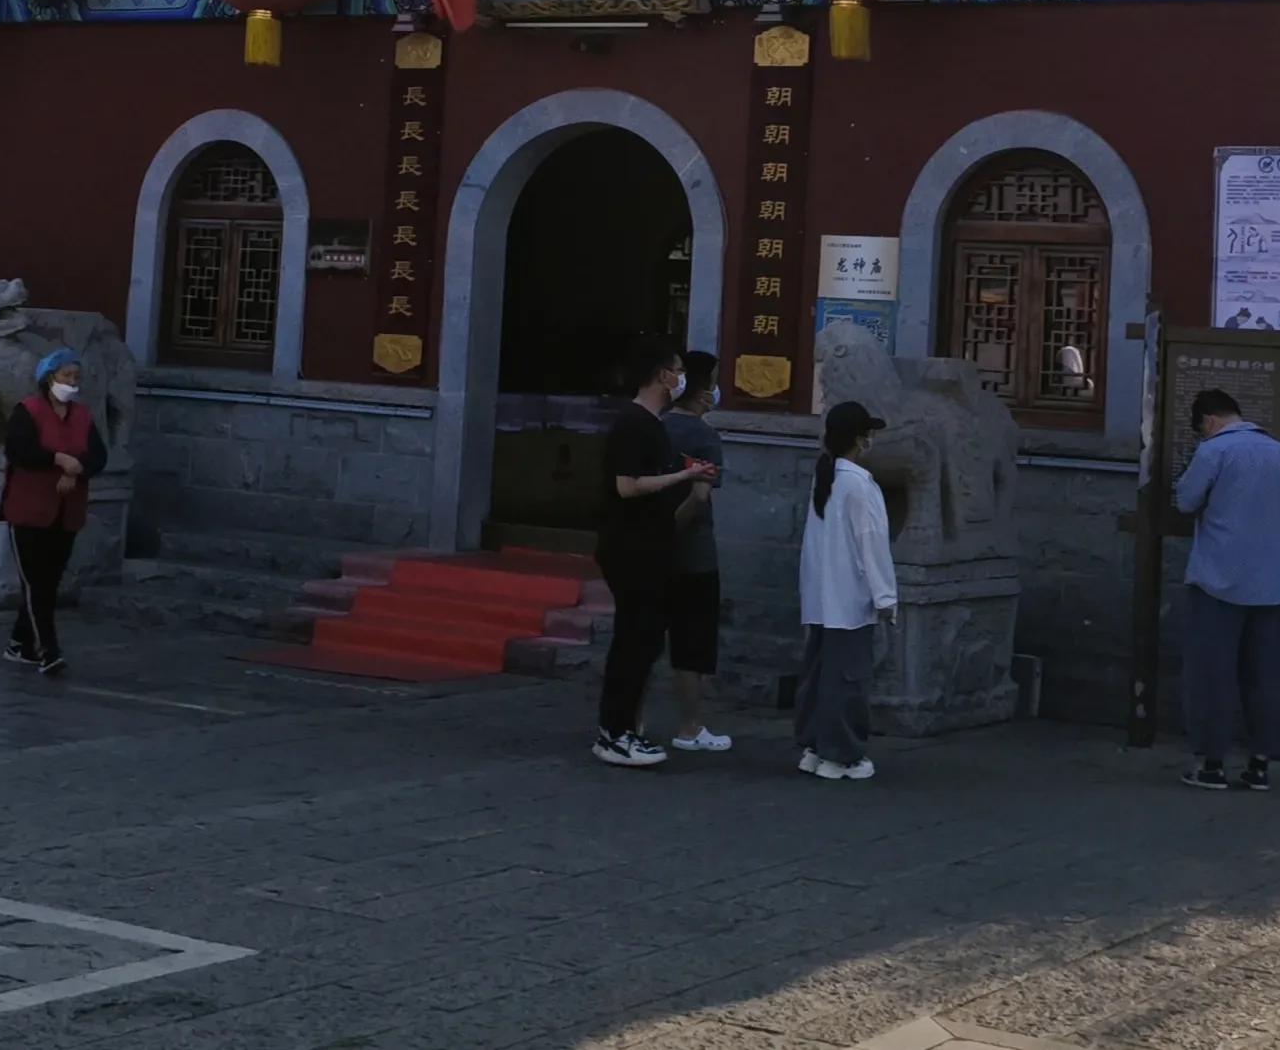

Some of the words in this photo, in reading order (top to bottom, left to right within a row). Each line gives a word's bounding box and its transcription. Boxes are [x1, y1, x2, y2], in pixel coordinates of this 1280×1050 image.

[751, 86, 793, 337] 朝朝朝朝朝朝朝
